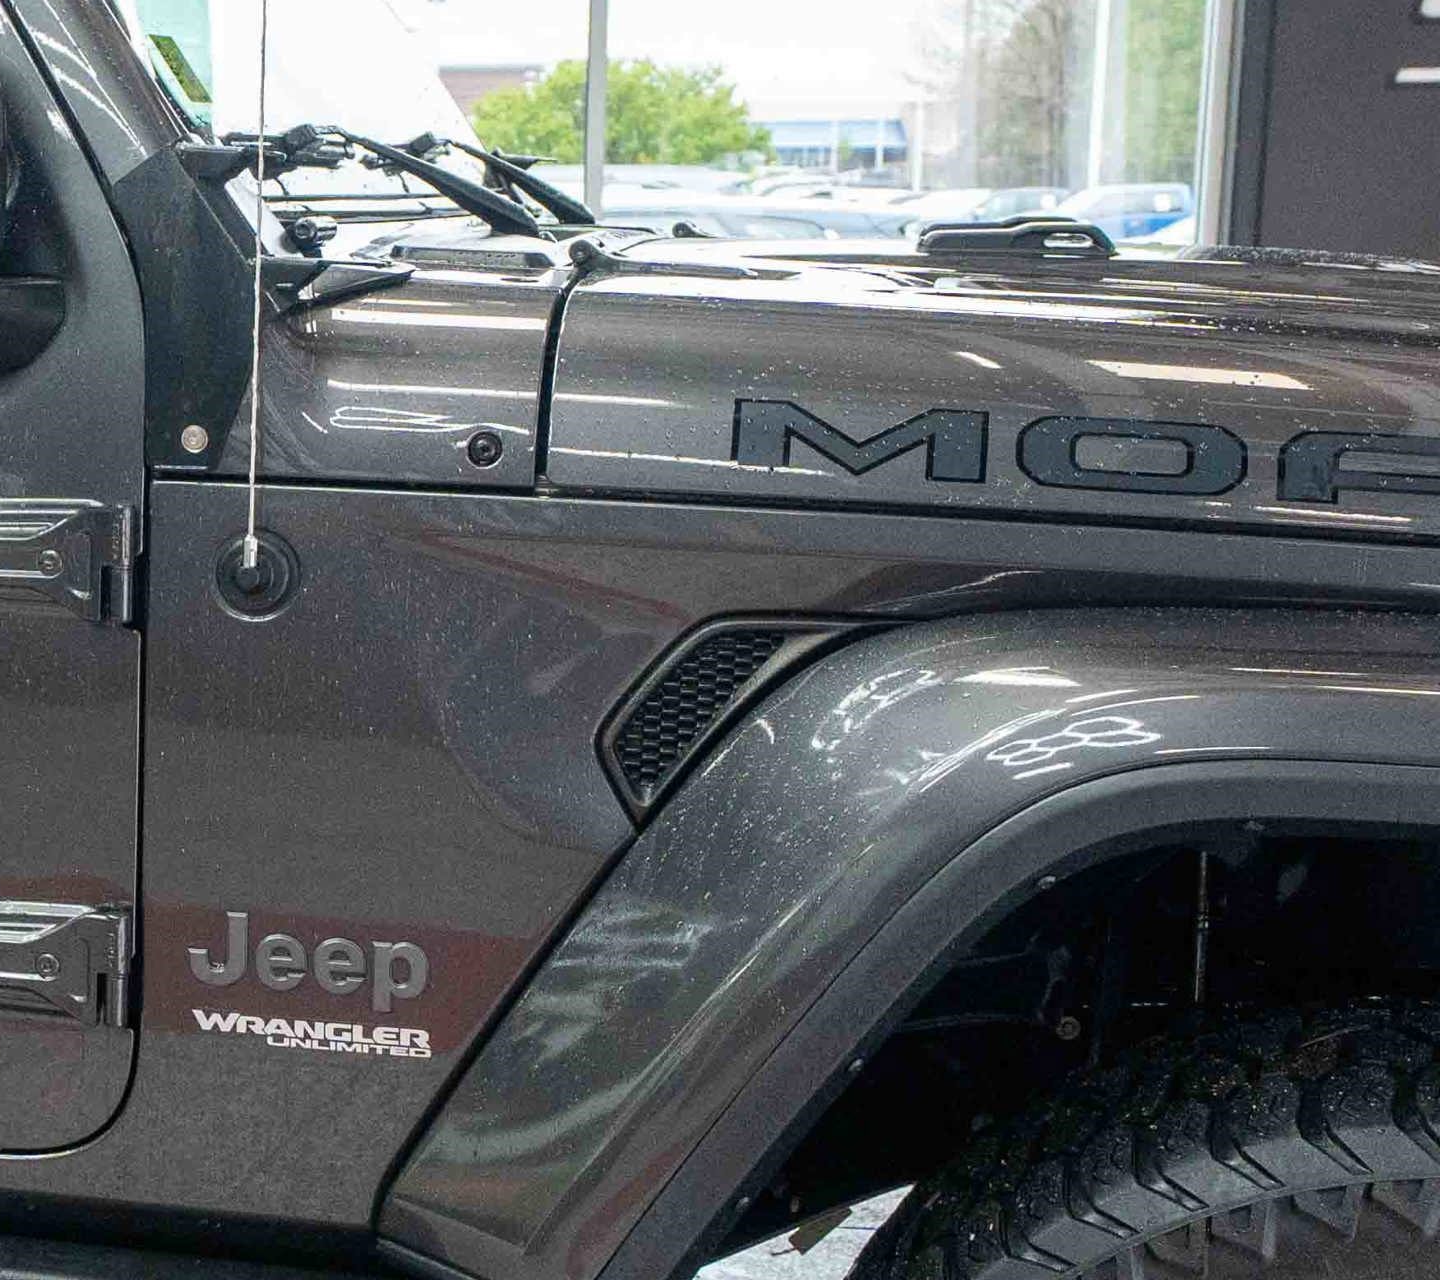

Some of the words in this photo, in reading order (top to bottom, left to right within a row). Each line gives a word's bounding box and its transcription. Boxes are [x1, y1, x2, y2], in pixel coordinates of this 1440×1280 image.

[188, 911, 430, 1012] Jeep
[192, 1009, 431, 1047] WRANGLER
[266, 1035, 432, 1058] UNLIMITED
